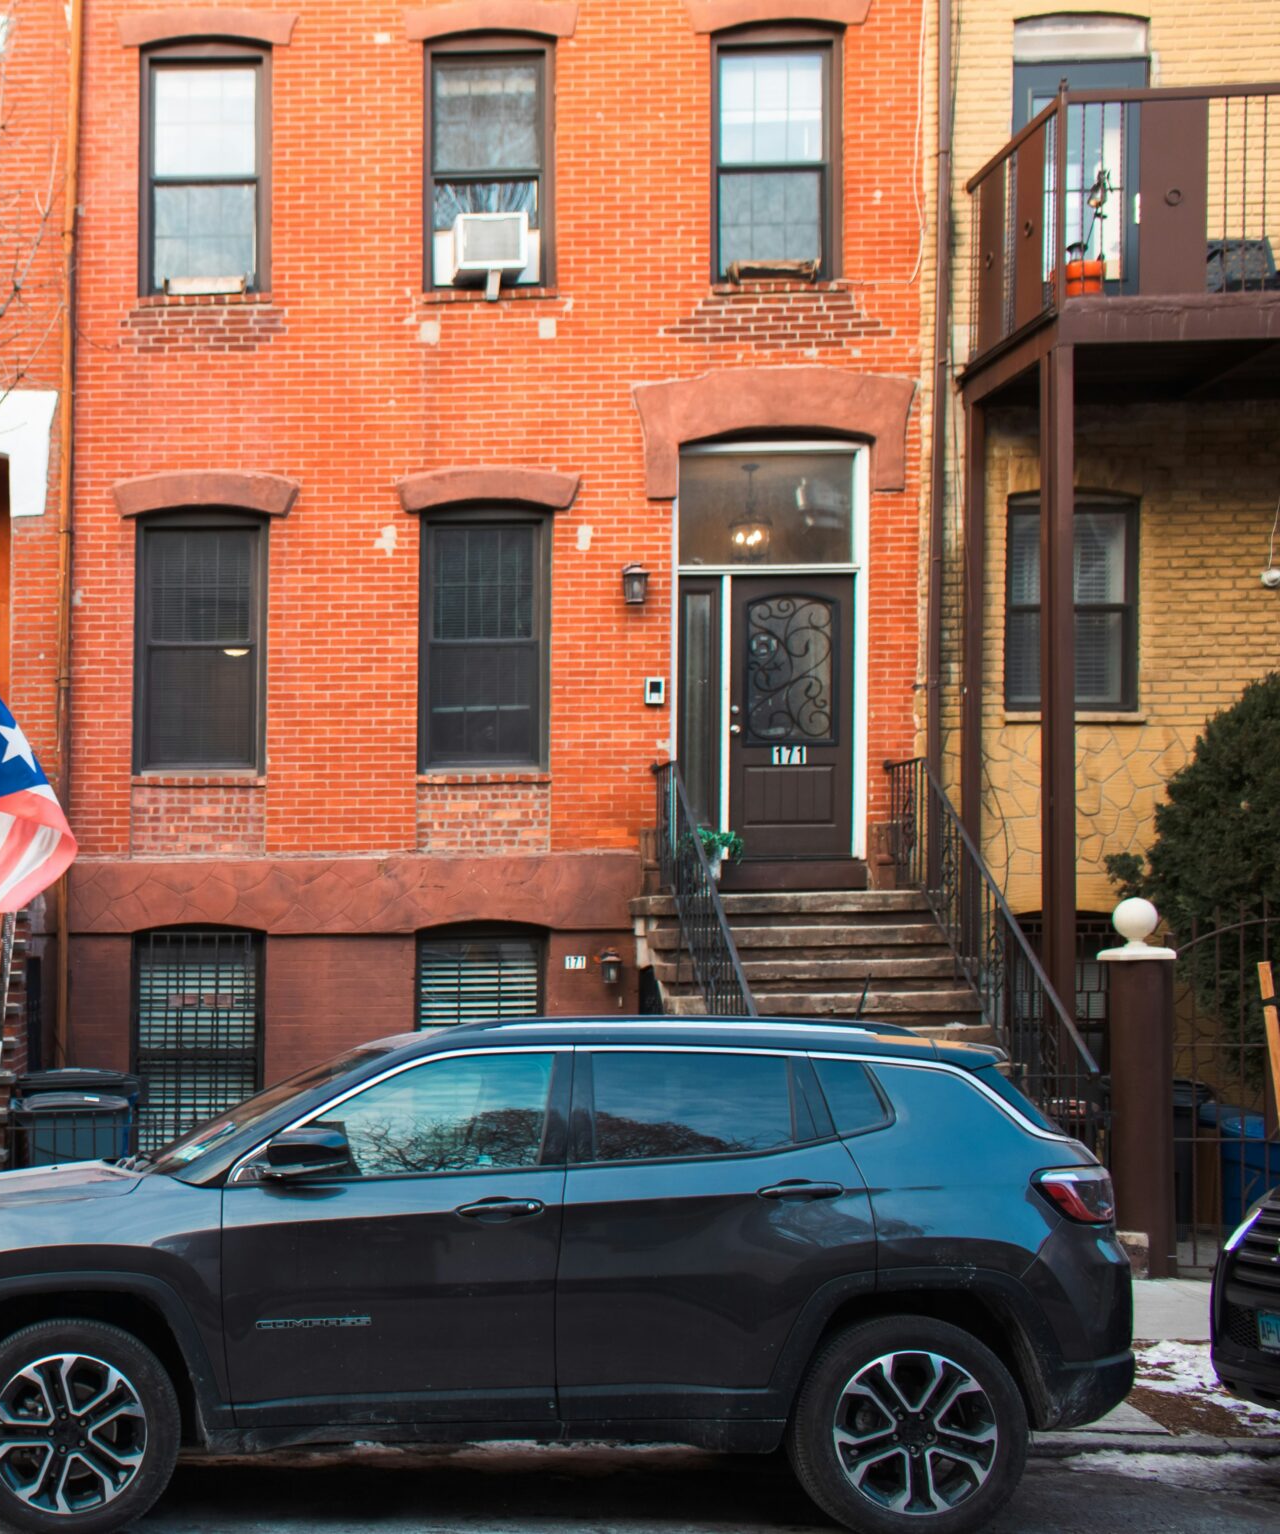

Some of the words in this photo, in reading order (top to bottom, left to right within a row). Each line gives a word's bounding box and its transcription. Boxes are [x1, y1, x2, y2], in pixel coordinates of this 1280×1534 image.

[774, 746, 805, 765] 171
[566, 956, 585, 969] 171
[256, 1316, 371, 1330] COMPASS
